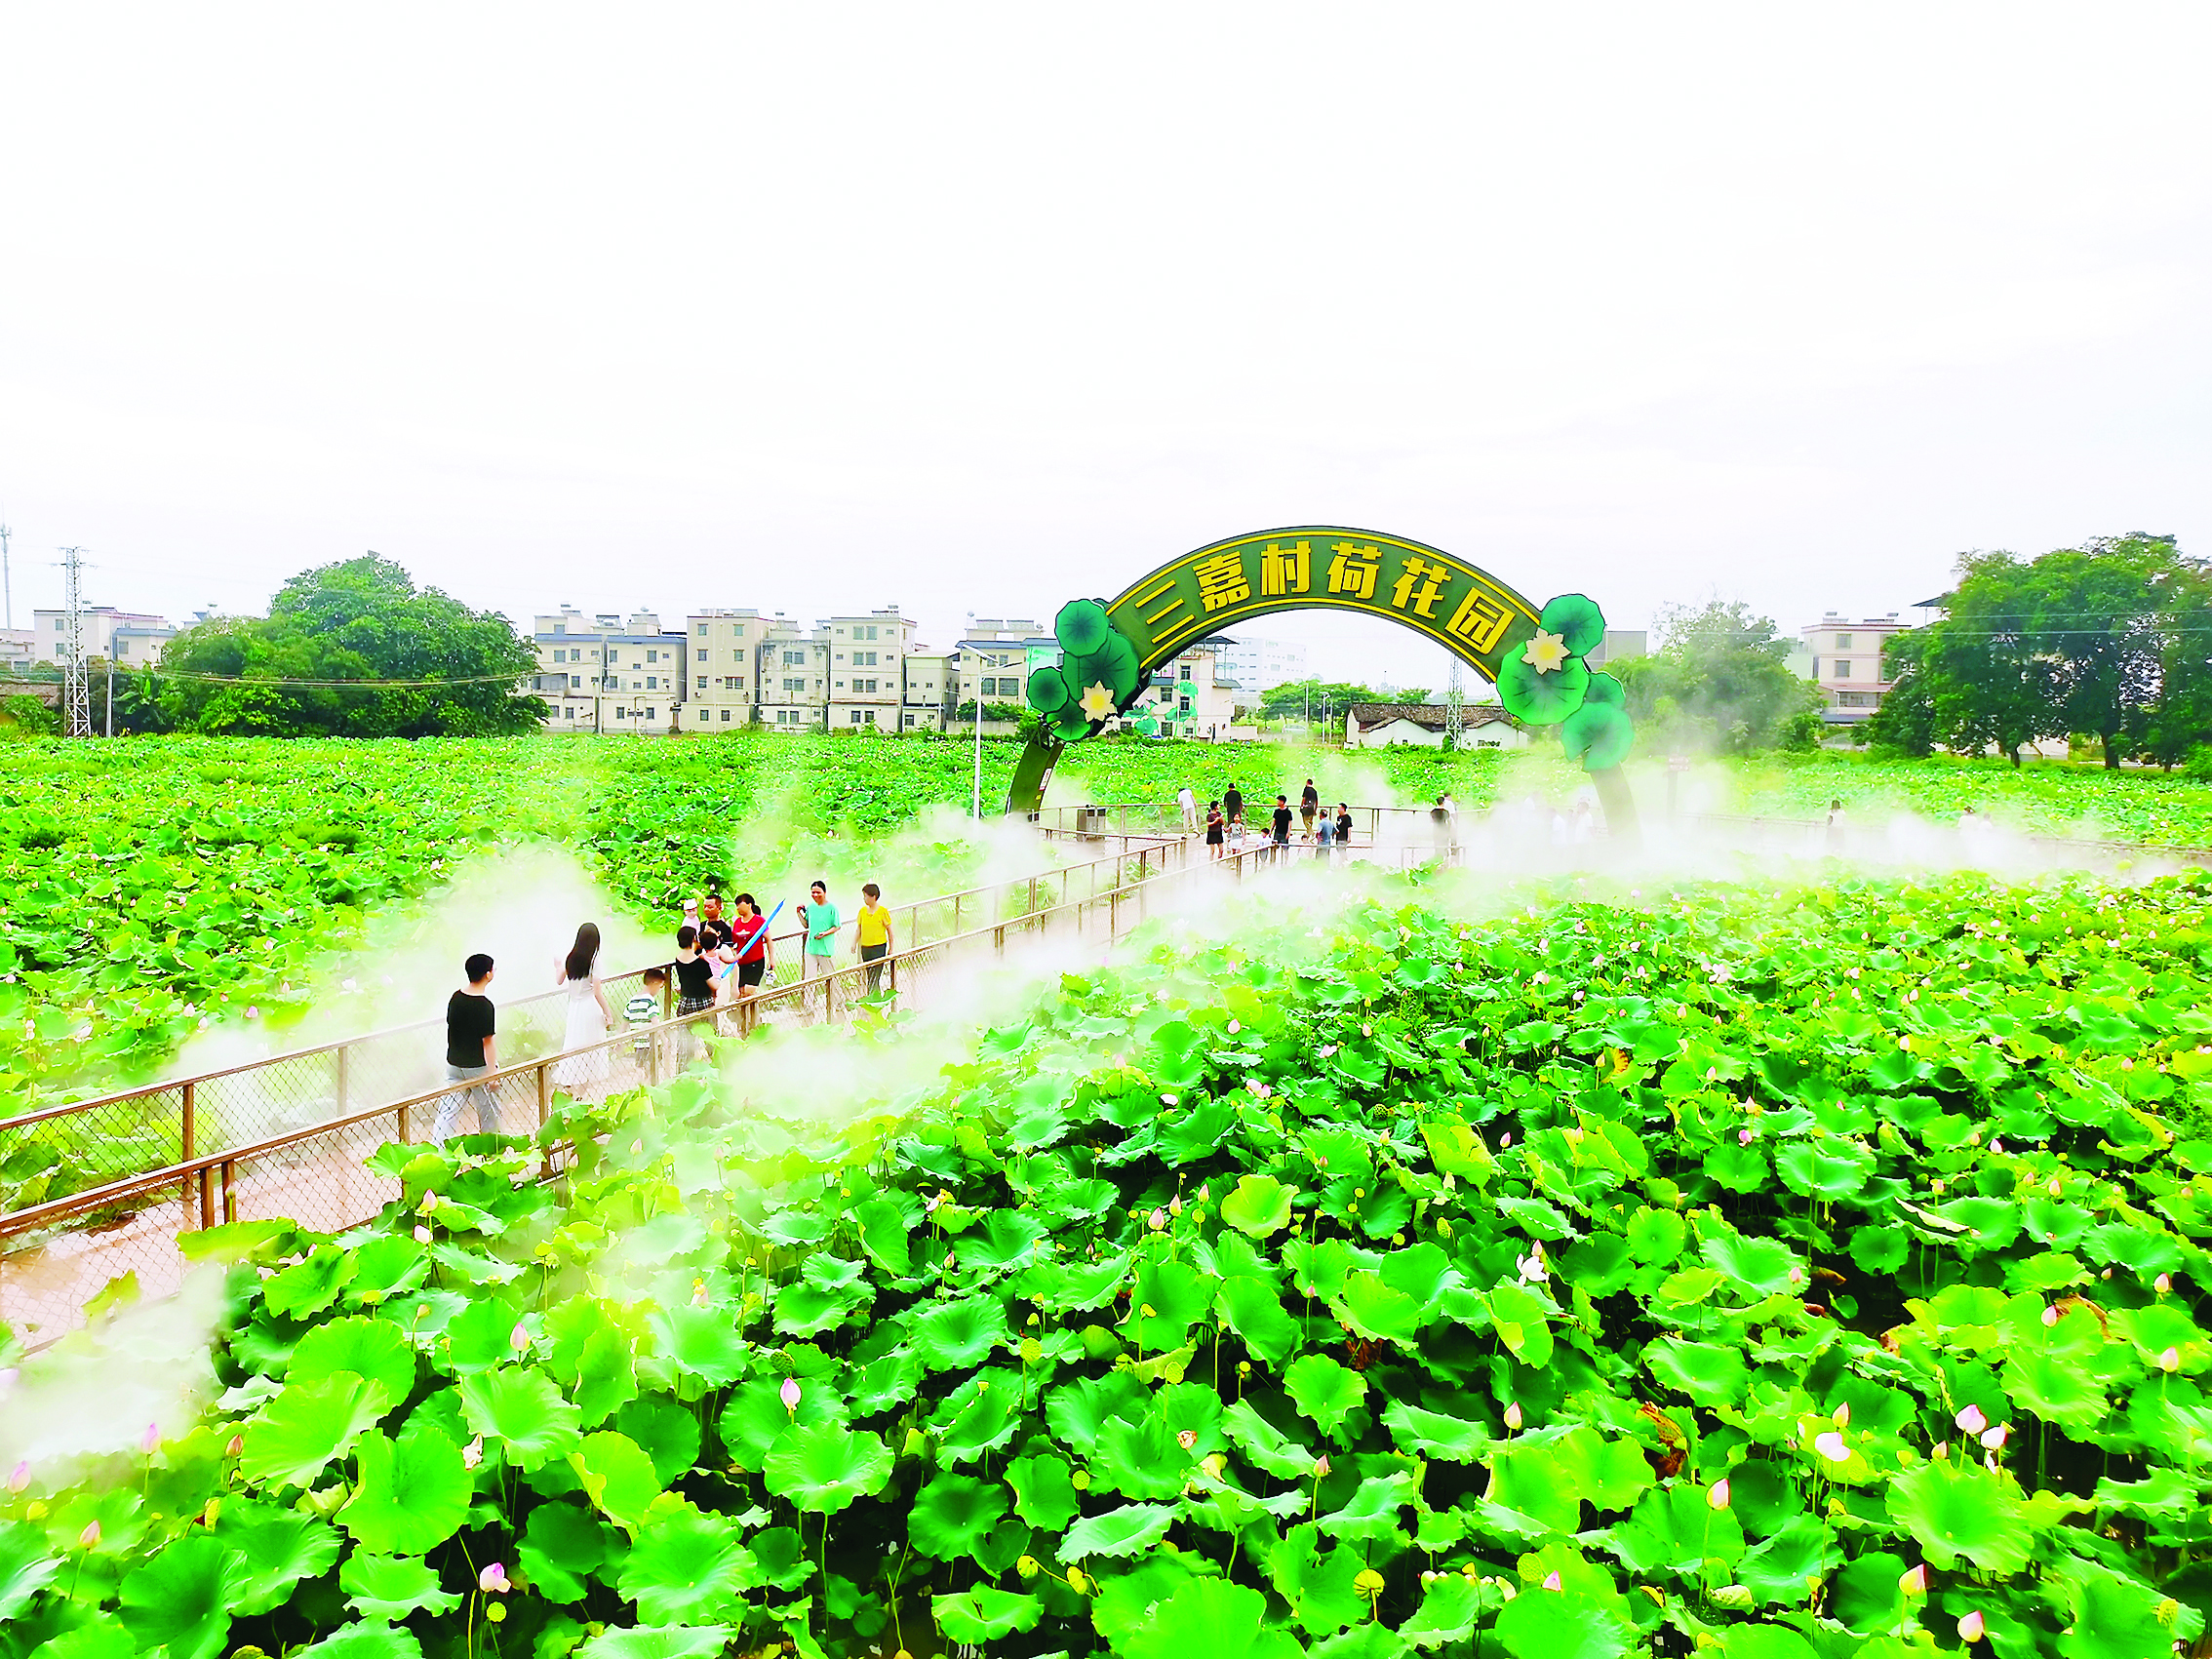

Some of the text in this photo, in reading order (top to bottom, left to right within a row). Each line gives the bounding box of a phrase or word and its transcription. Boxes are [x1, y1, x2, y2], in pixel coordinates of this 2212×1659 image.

[1134, 540, 1516, 654] 三嘉村荷花园
